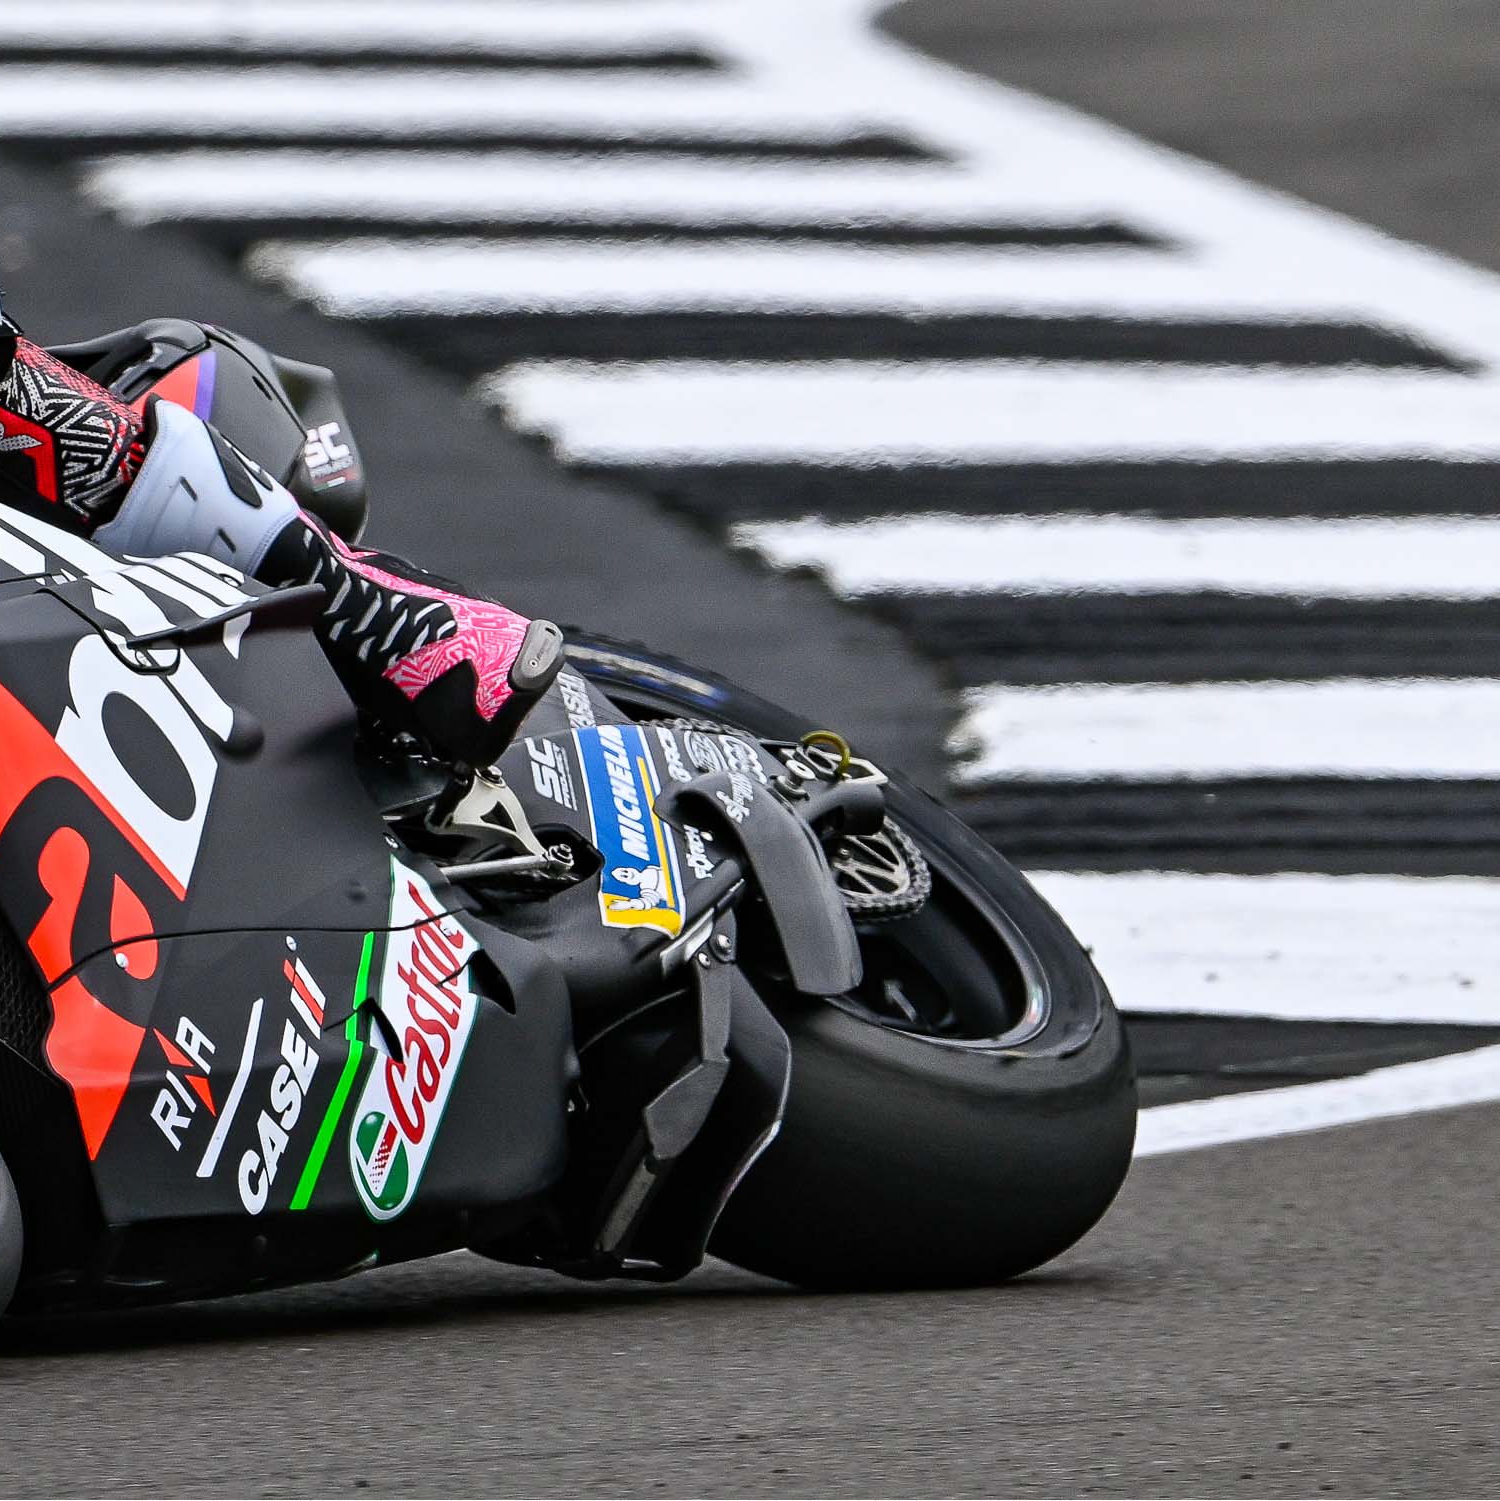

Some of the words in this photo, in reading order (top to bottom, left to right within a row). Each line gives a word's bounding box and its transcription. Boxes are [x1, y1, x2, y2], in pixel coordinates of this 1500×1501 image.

[524, 737, 564, 806] SC
[597, 724, 651, 862] MICHELIN
[385, 880, 465, 1145] Castrol
[238, 1018, 320, 1216] CASE
